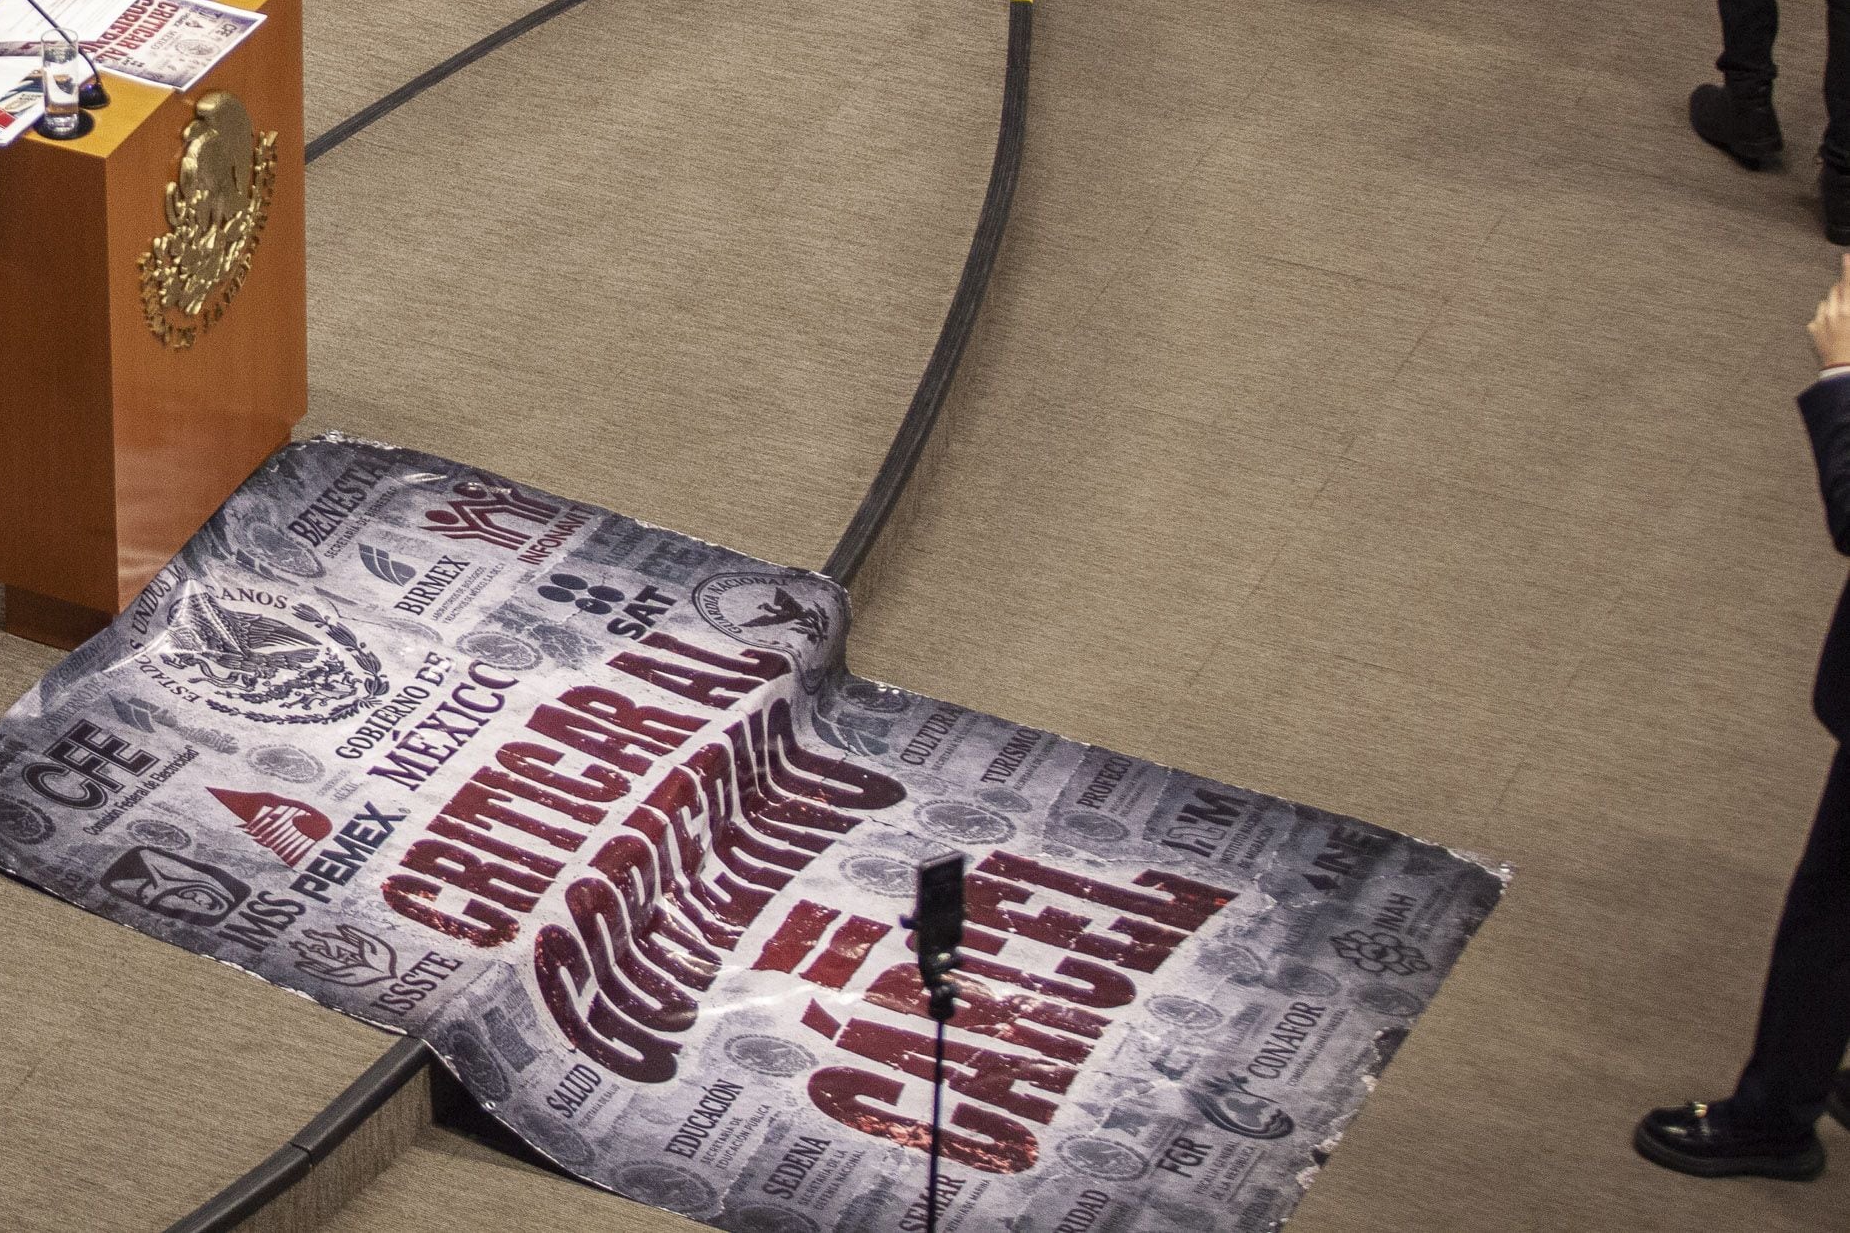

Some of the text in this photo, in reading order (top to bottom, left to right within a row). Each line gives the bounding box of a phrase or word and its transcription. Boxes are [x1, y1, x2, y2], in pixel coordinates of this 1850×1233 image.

[122, 1, 181, 51] CRITICAR
[517, 505, 596, 566] INFONAVIT
[132, 576, 172, 635] UNIDOS
[394, 554, 470, 616] BIRMEX
[607, 585, 677, 640] SAT
[703, 577, 789, 634] GUARDIA NACIONAL
[336, 651, 457, 759] GOBIERNO DE
[367, 659, 520, 792] MÉXICO
[901, 704, 965, 766] CULTURA
[21, 718, 160, 810] CFE
[980, 728, 1043, 784] TURISMO
[1076, 755, 1134, 810] PROFECO
[117, 786, 150, 813] Federal
[381, 631, 792, 948] CRITICAR AL
[289, 800, 407, 904] PEMEX
[215, 890, 307, 953] IMSS
[534, 697, 907, 1084] GOBIERNO
[1371, 892, 1417, 932] INAH
[370, 952, 464, 1017] ISSSTE
[807, 849, 1240, 1174] CÁRCEL
[1248, 1001, 1326, 1080] CONAFOR
[546, 1064, 602, 1119] SALUD
[664, 1077, 745, 1160] EDUCACIÓN
[716, 1104, 769, 1169] EDUCACIÓN PÚBLICA
[762, 1134, 832, 1200] SEDENA
[834, 1148, 863, 1181] NACIONAL
[1155, 1136, 1213, 1178] FGR
